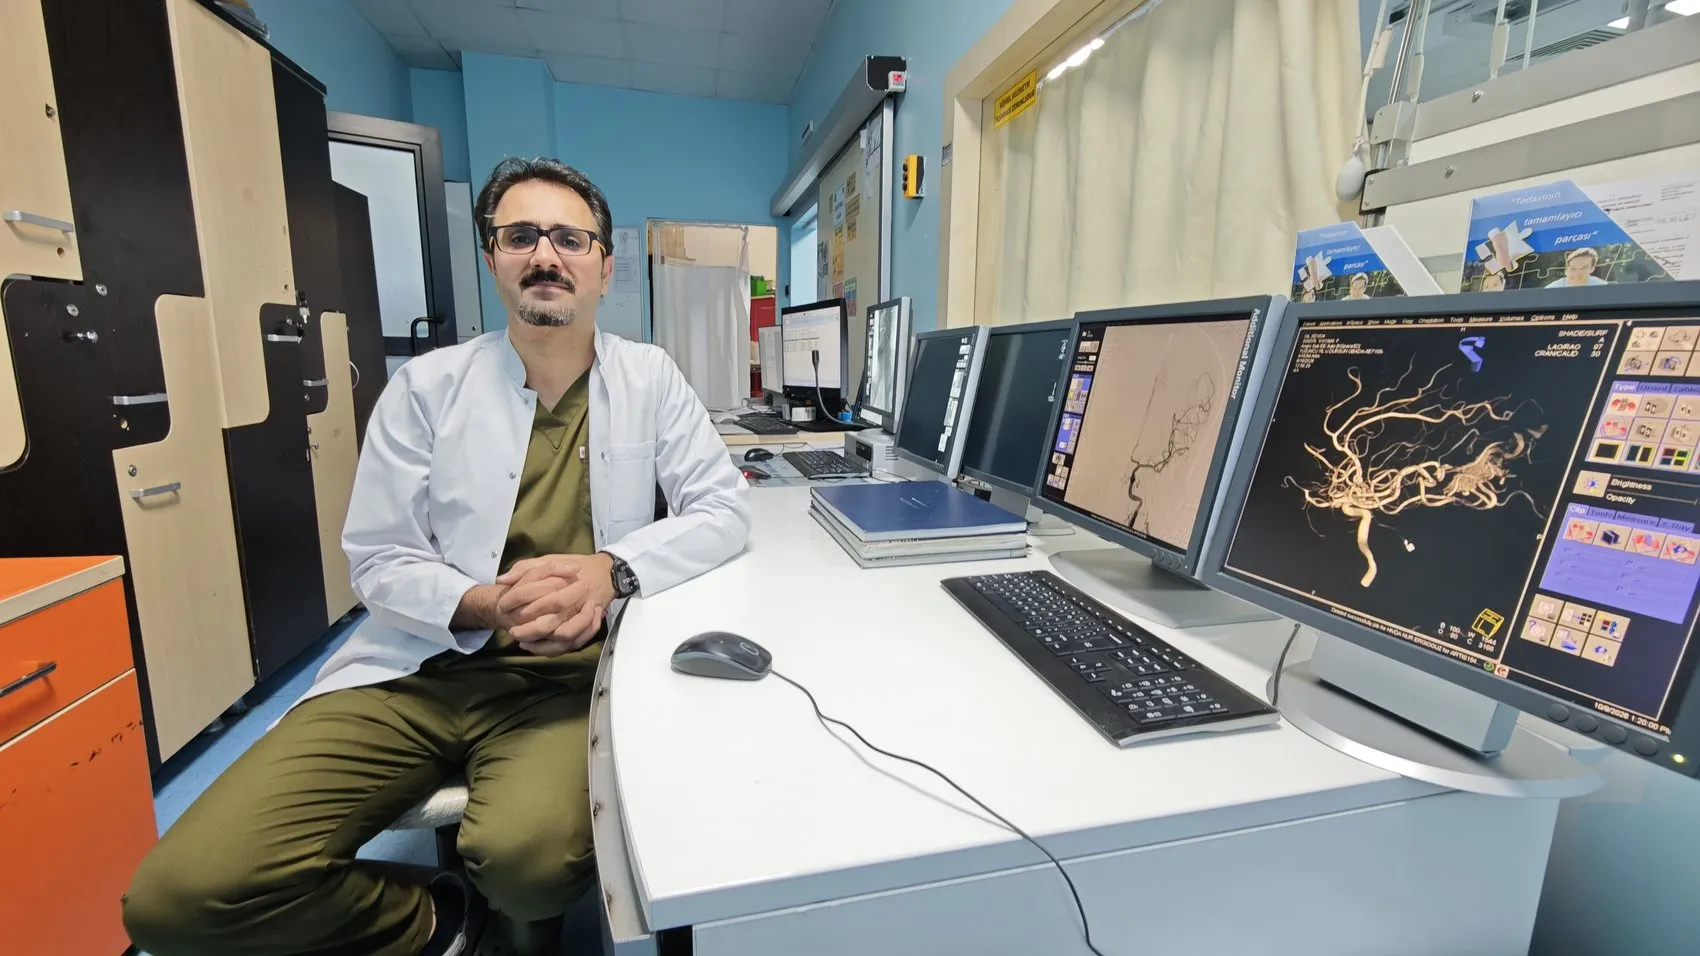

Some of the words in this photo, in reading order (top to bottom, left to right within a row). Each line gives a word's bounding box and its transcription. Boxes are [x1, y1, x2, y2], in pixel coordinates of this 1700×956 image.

[1524, 210, 1583, 226] tamamlayıcı
[1530, 314, 1555, 322] Options
[1561, 313, 1579, 321] Help
[1241, 308, 1261, 359] Additional
[1231, 360, 1247, 399] Monitor
[1615, 383, 1636, 391] Type
[1611, 479, 1653, 491] Brightness
[1606, 493, 1637, 505] Opacity
